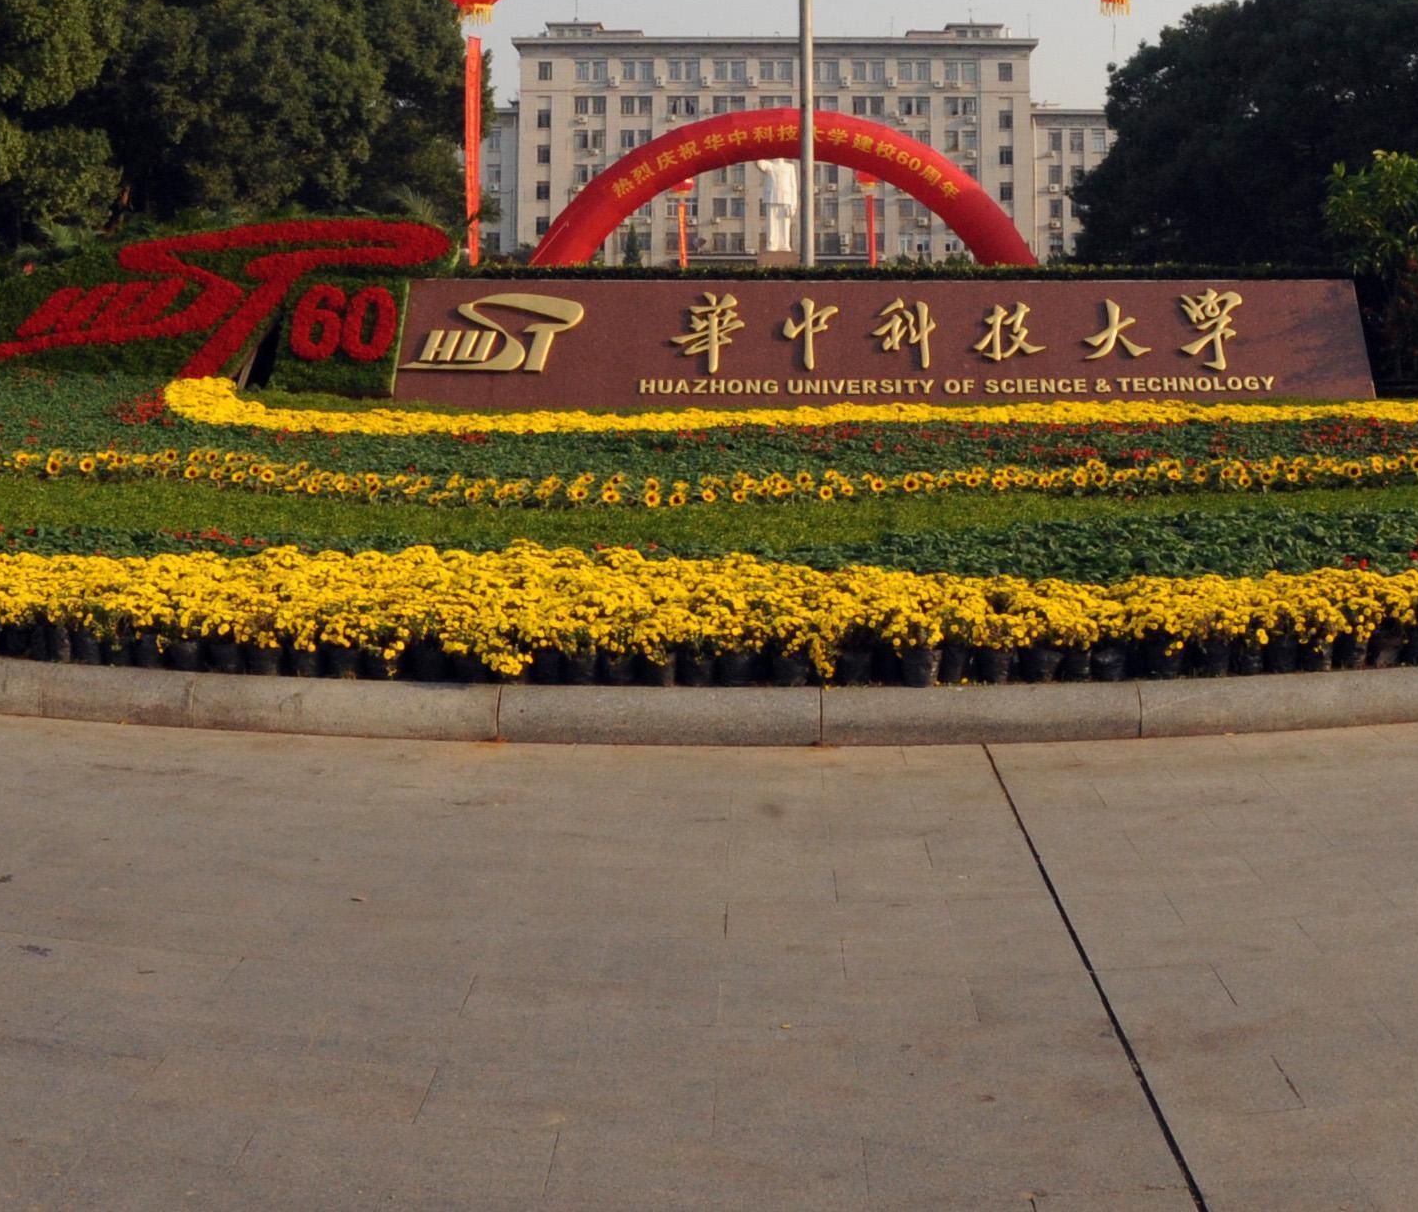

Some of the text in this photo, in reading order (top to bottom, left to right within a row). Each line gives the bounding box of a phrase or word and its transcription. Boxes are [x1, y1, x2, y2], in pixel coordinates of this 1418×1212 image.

[290, 284, 397, 361] 60
[639, 376, 1275, 394] HUAZHONG UNIVERSITY OF SCIENCE & TECHNOLOGY
